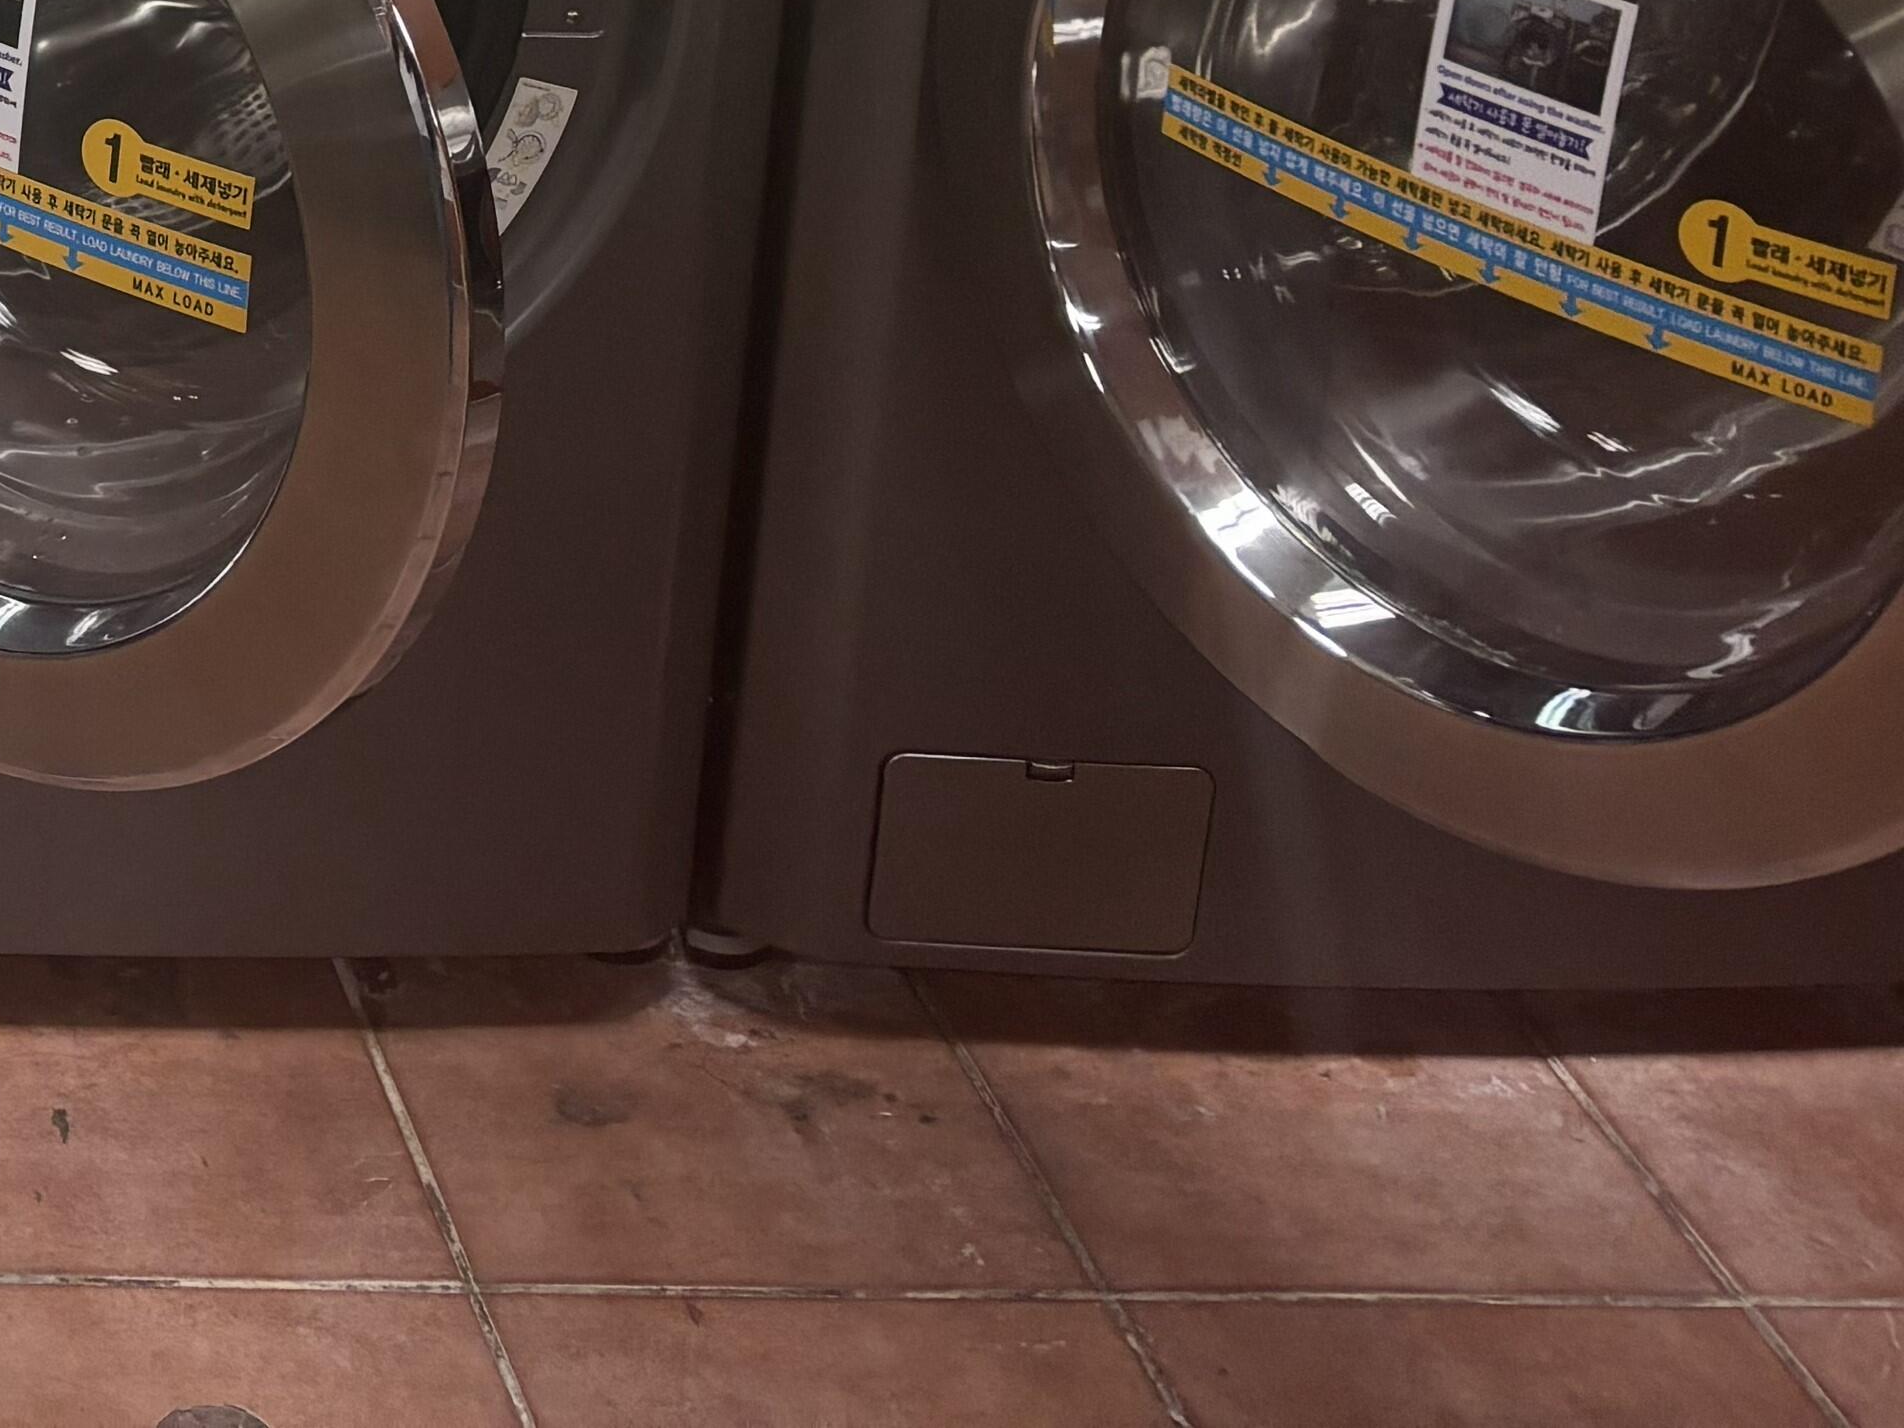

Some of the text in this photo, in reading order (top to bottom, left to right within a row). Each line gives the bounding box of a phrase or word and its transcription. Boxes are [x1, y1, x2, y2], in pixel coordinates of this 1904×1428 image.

[104, 133, 122, 184] 1
[139, 154, 248, 205] 빨래 세제넣기
[1707, 214, 1729, 269] 1
[132, 276, 214, 317] MAX LOAD
[1805, 255, 1887, 293] 세제넣기
[1729, 360, 1834, 408] MAX LOAD
